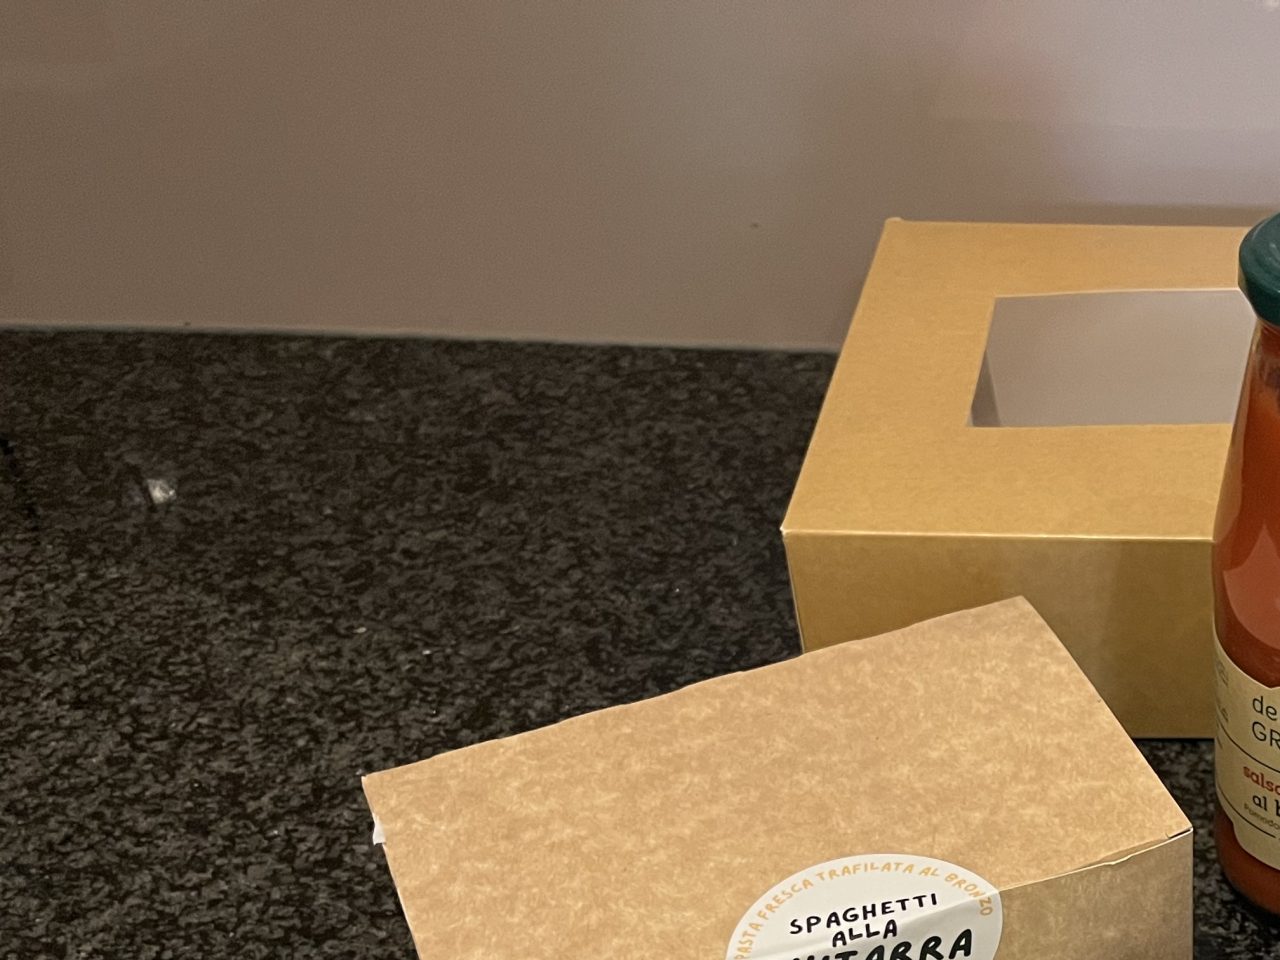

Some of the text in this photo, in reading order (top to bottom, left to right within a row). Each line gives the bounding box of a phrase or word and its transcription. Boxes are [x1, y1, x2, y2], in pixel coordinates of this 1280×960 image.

[1252, 794, 1268, 811] al
[734, 861, 994, 960] PASTA FRESCA TRAFILATA AL BRONZO
[789, 893, 937, 935] SPAGHETTI
[832, 919, 898, 947] ALLA
